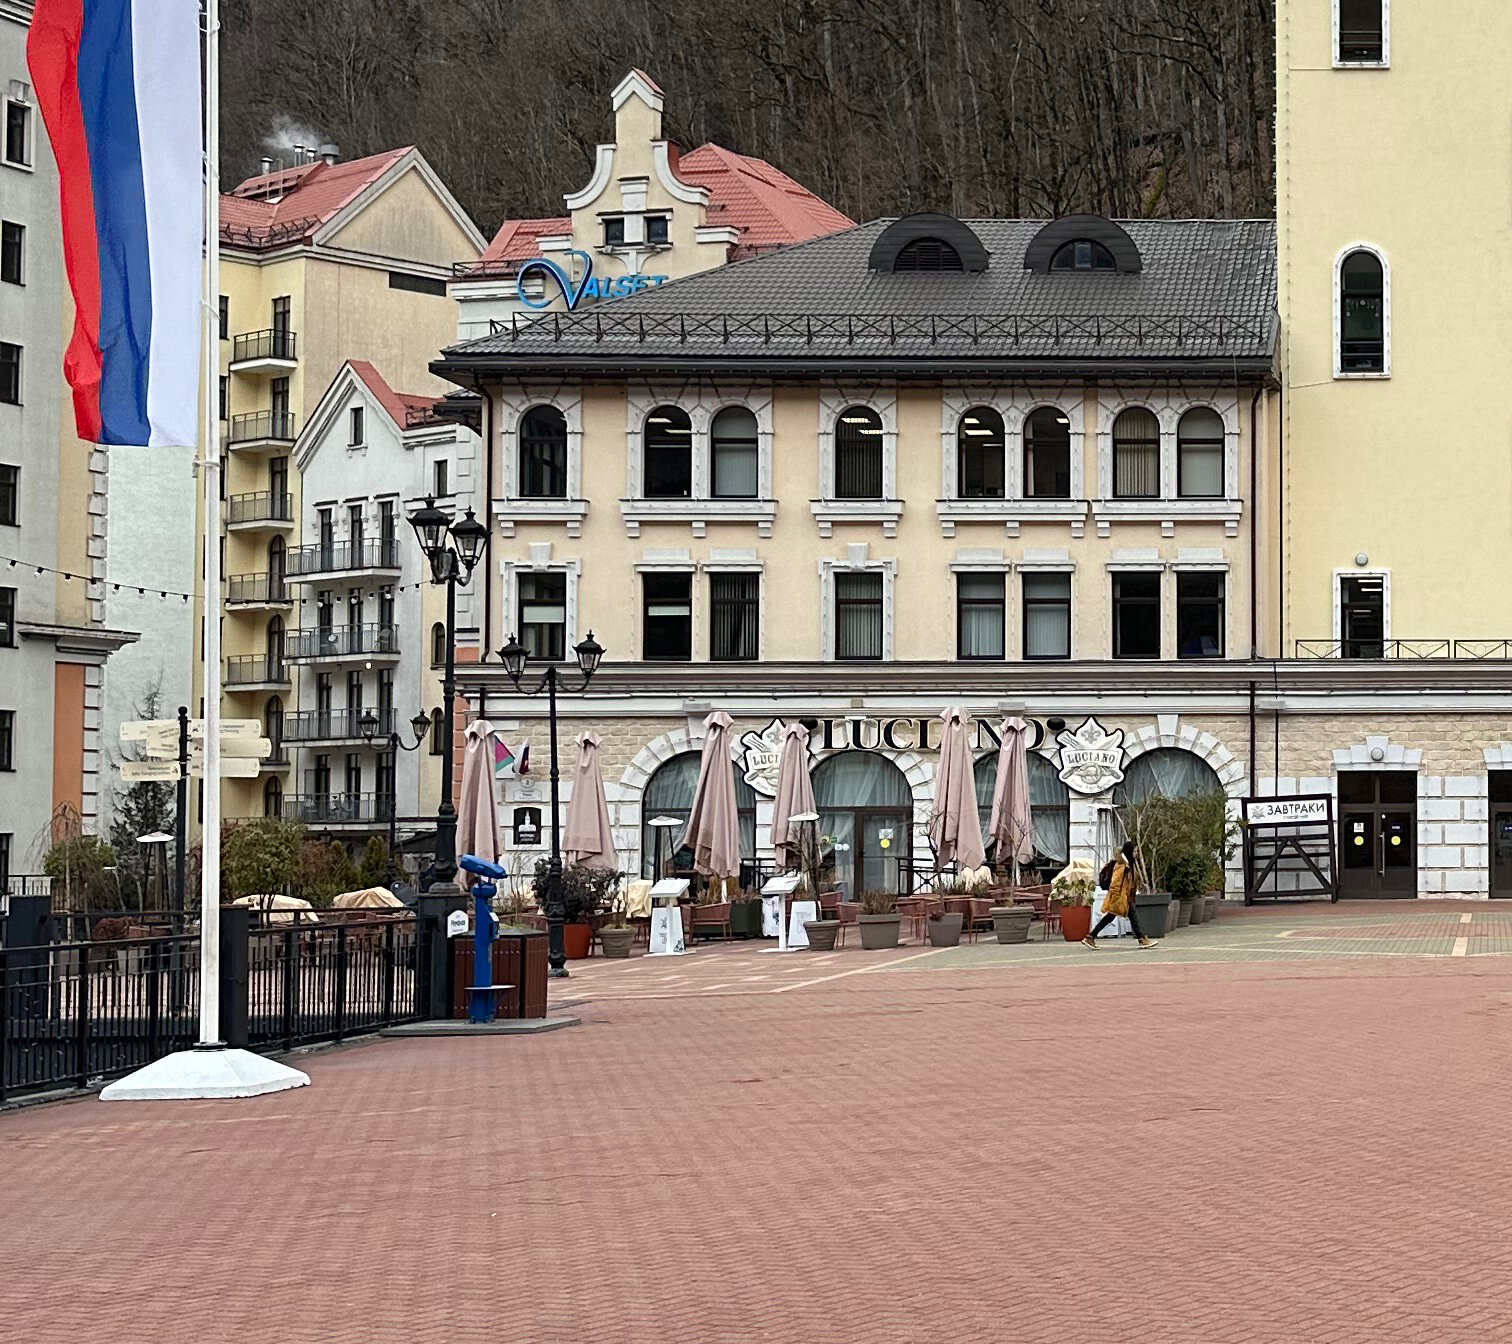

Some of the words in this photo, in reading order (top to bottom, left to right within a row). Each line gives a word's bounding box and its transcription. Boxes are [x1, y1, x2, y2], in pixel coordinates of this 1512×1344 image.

[820, 718, 1046, 750] LUCINO
[1066, 751, 1116, 765] LUCIANO
[1267, 802, 1325, 816] ЗАВТРАКИ
